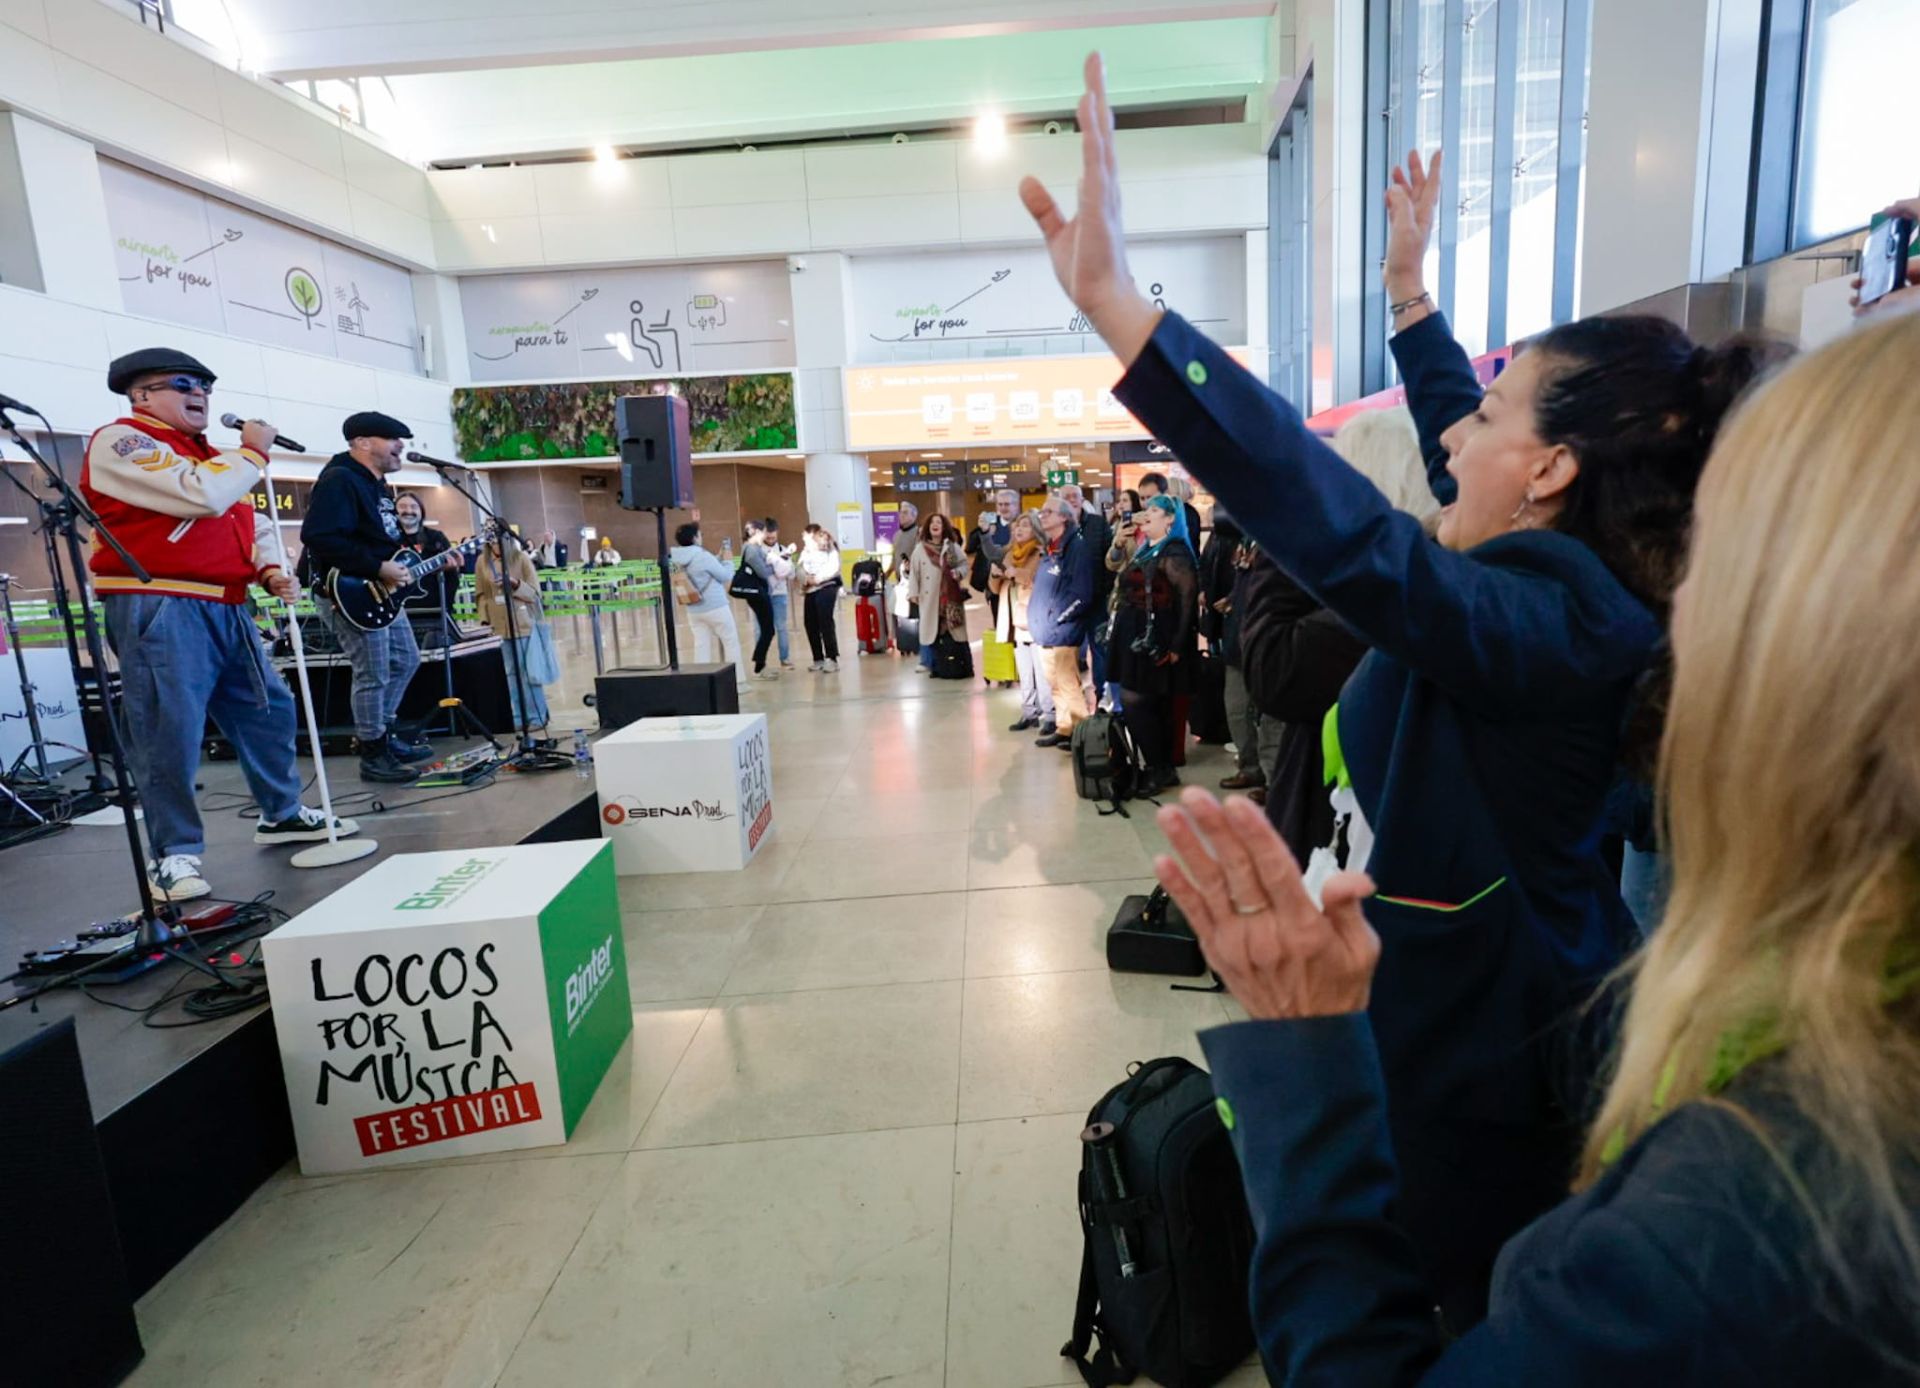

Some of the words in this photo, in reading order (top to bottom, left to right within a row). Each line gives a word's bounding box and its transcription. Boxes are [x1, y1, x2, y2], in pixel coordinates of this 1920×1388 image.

[146, 257, 173, 284] for
[178, 271, 212, 293] you
[514, 336, 552, 352] para
[553, 330, 568, 345] ti
[914, 317, 935, 337] for
[939, 318, 968, 337] you
[628, 806, 692, 818] SENA
[394, 858, 492, 910] Binter
[311, 943, 498, 1007] LOCOS
[566, 934, 613, 1024] Binter
[317, 1012, 406, 1050] POR
[421, 1001, 513, 1058] LA
[315, 1042, 519, 1106] MÚSICA
[368, 1090, 531, 1150] FESTIVAL
